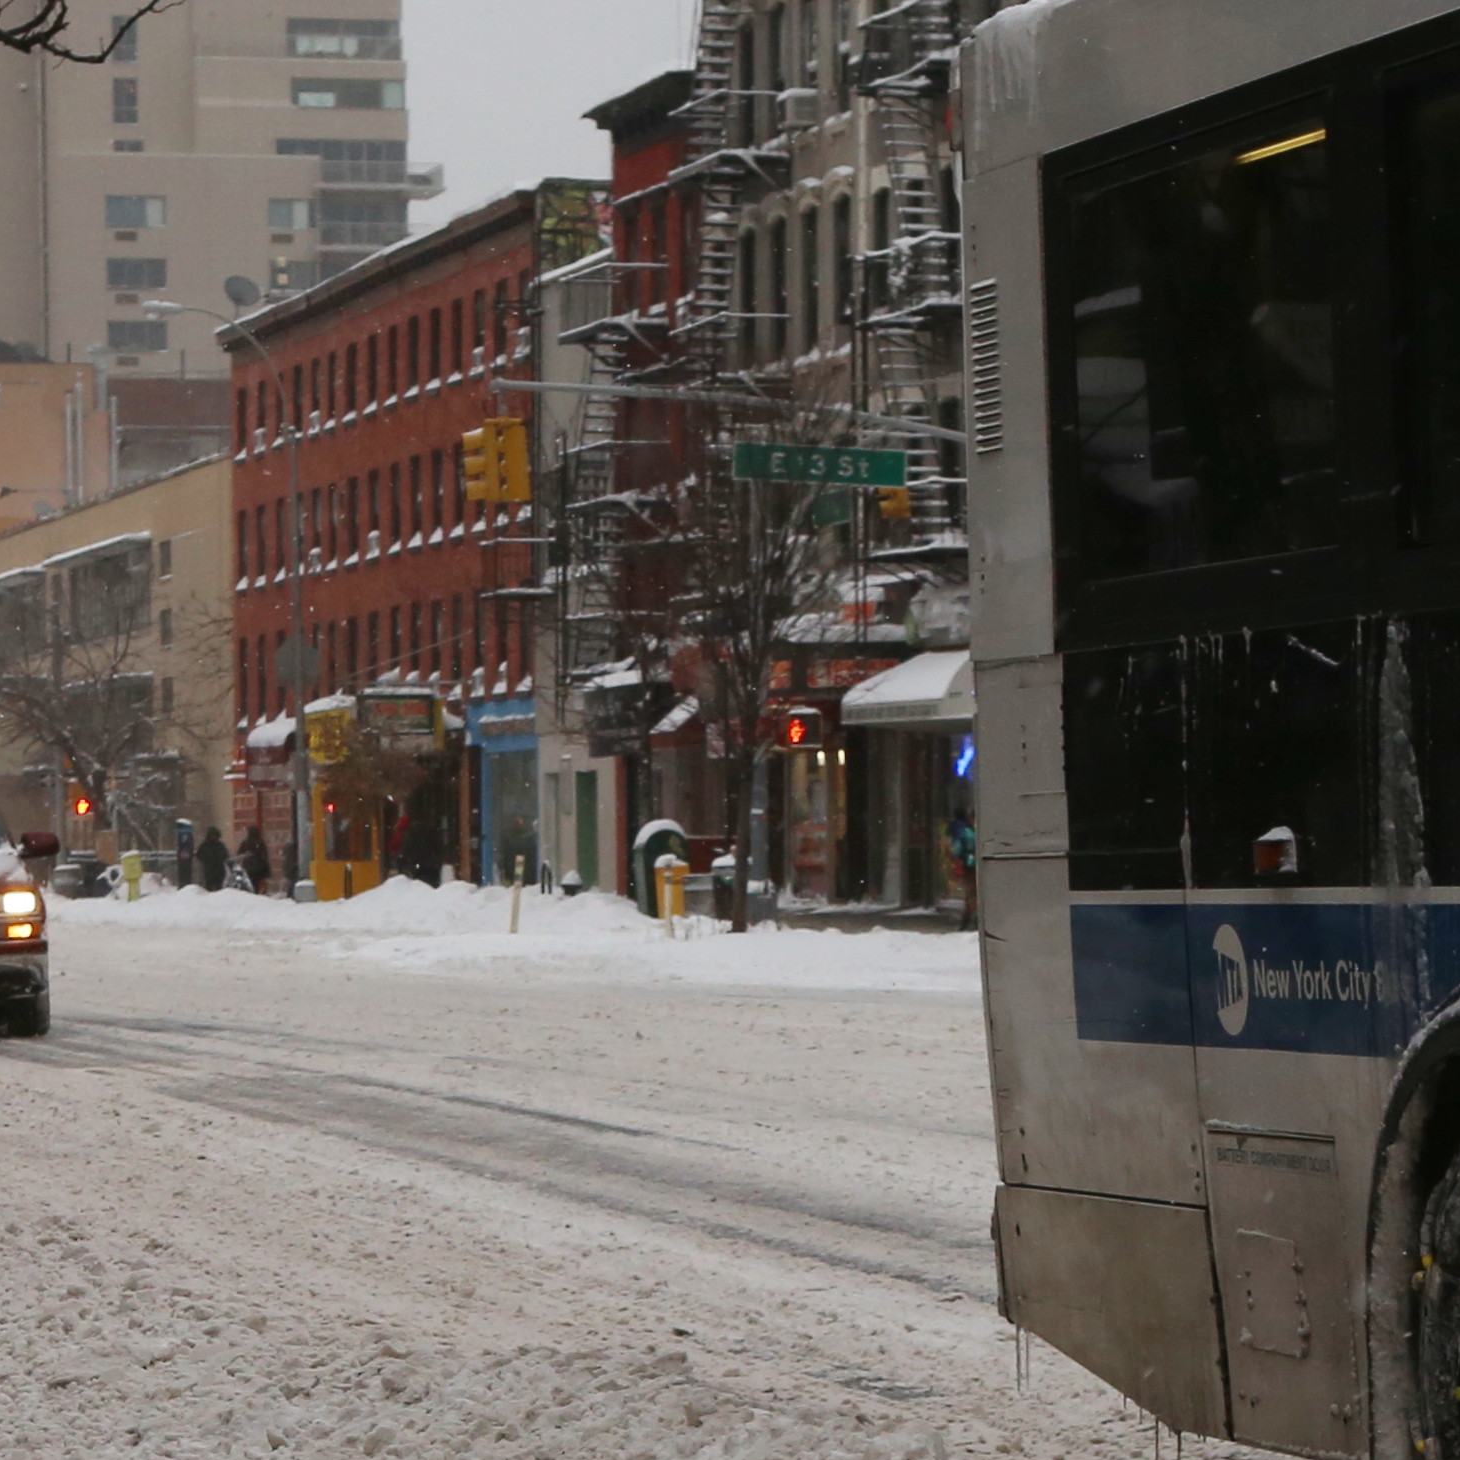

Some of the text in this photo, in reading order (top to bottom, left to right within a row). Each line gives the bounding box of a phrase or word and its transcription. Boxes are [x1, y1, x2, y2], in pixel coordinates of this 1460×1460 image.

[771, 452, 786, 473] E
[837, 456, 870, 478] St
[1253, 959, 1290, 998] New
[1292, 960, 1332, 1000] York
[1336, 959, 1371, 1010] City
